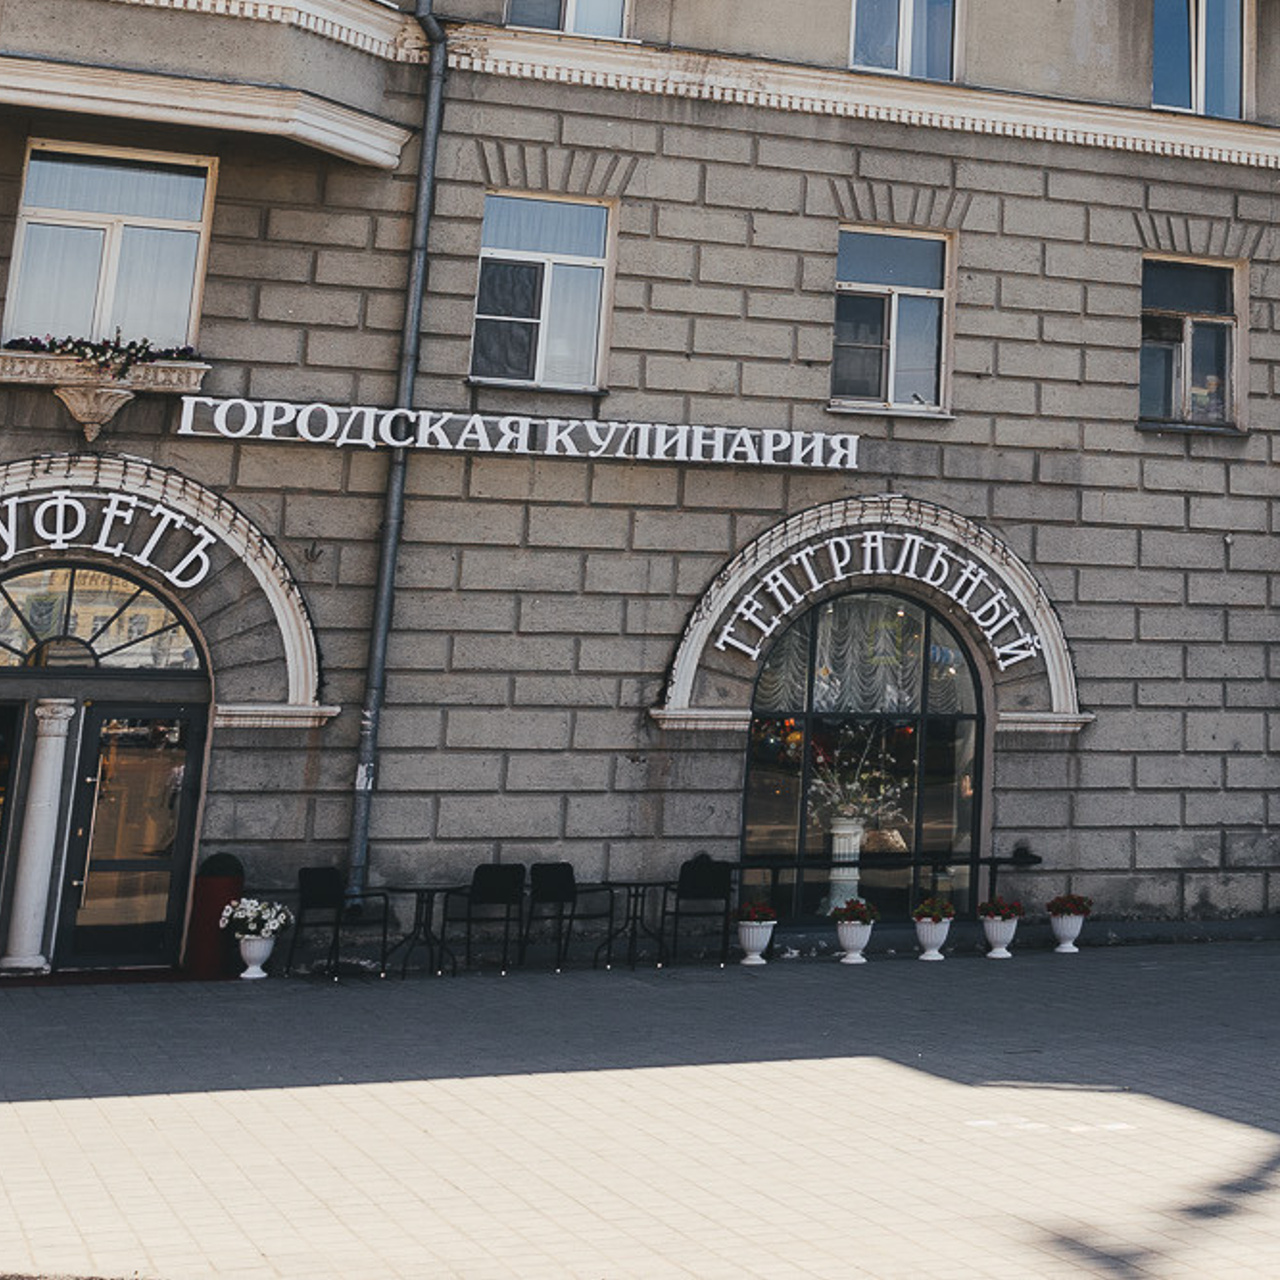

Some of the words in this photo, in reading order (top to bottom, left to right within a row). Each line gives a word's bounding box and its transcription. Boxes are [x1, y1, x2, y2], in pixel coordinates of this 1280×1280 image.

[177, 396, 532, 454] ГОРОДСКАЯ
[544, 418, 860, 470] КУЛИНАРИЯ
[714, 531, 1043, 671] ТЕАТРАЛЬНЫЙ
